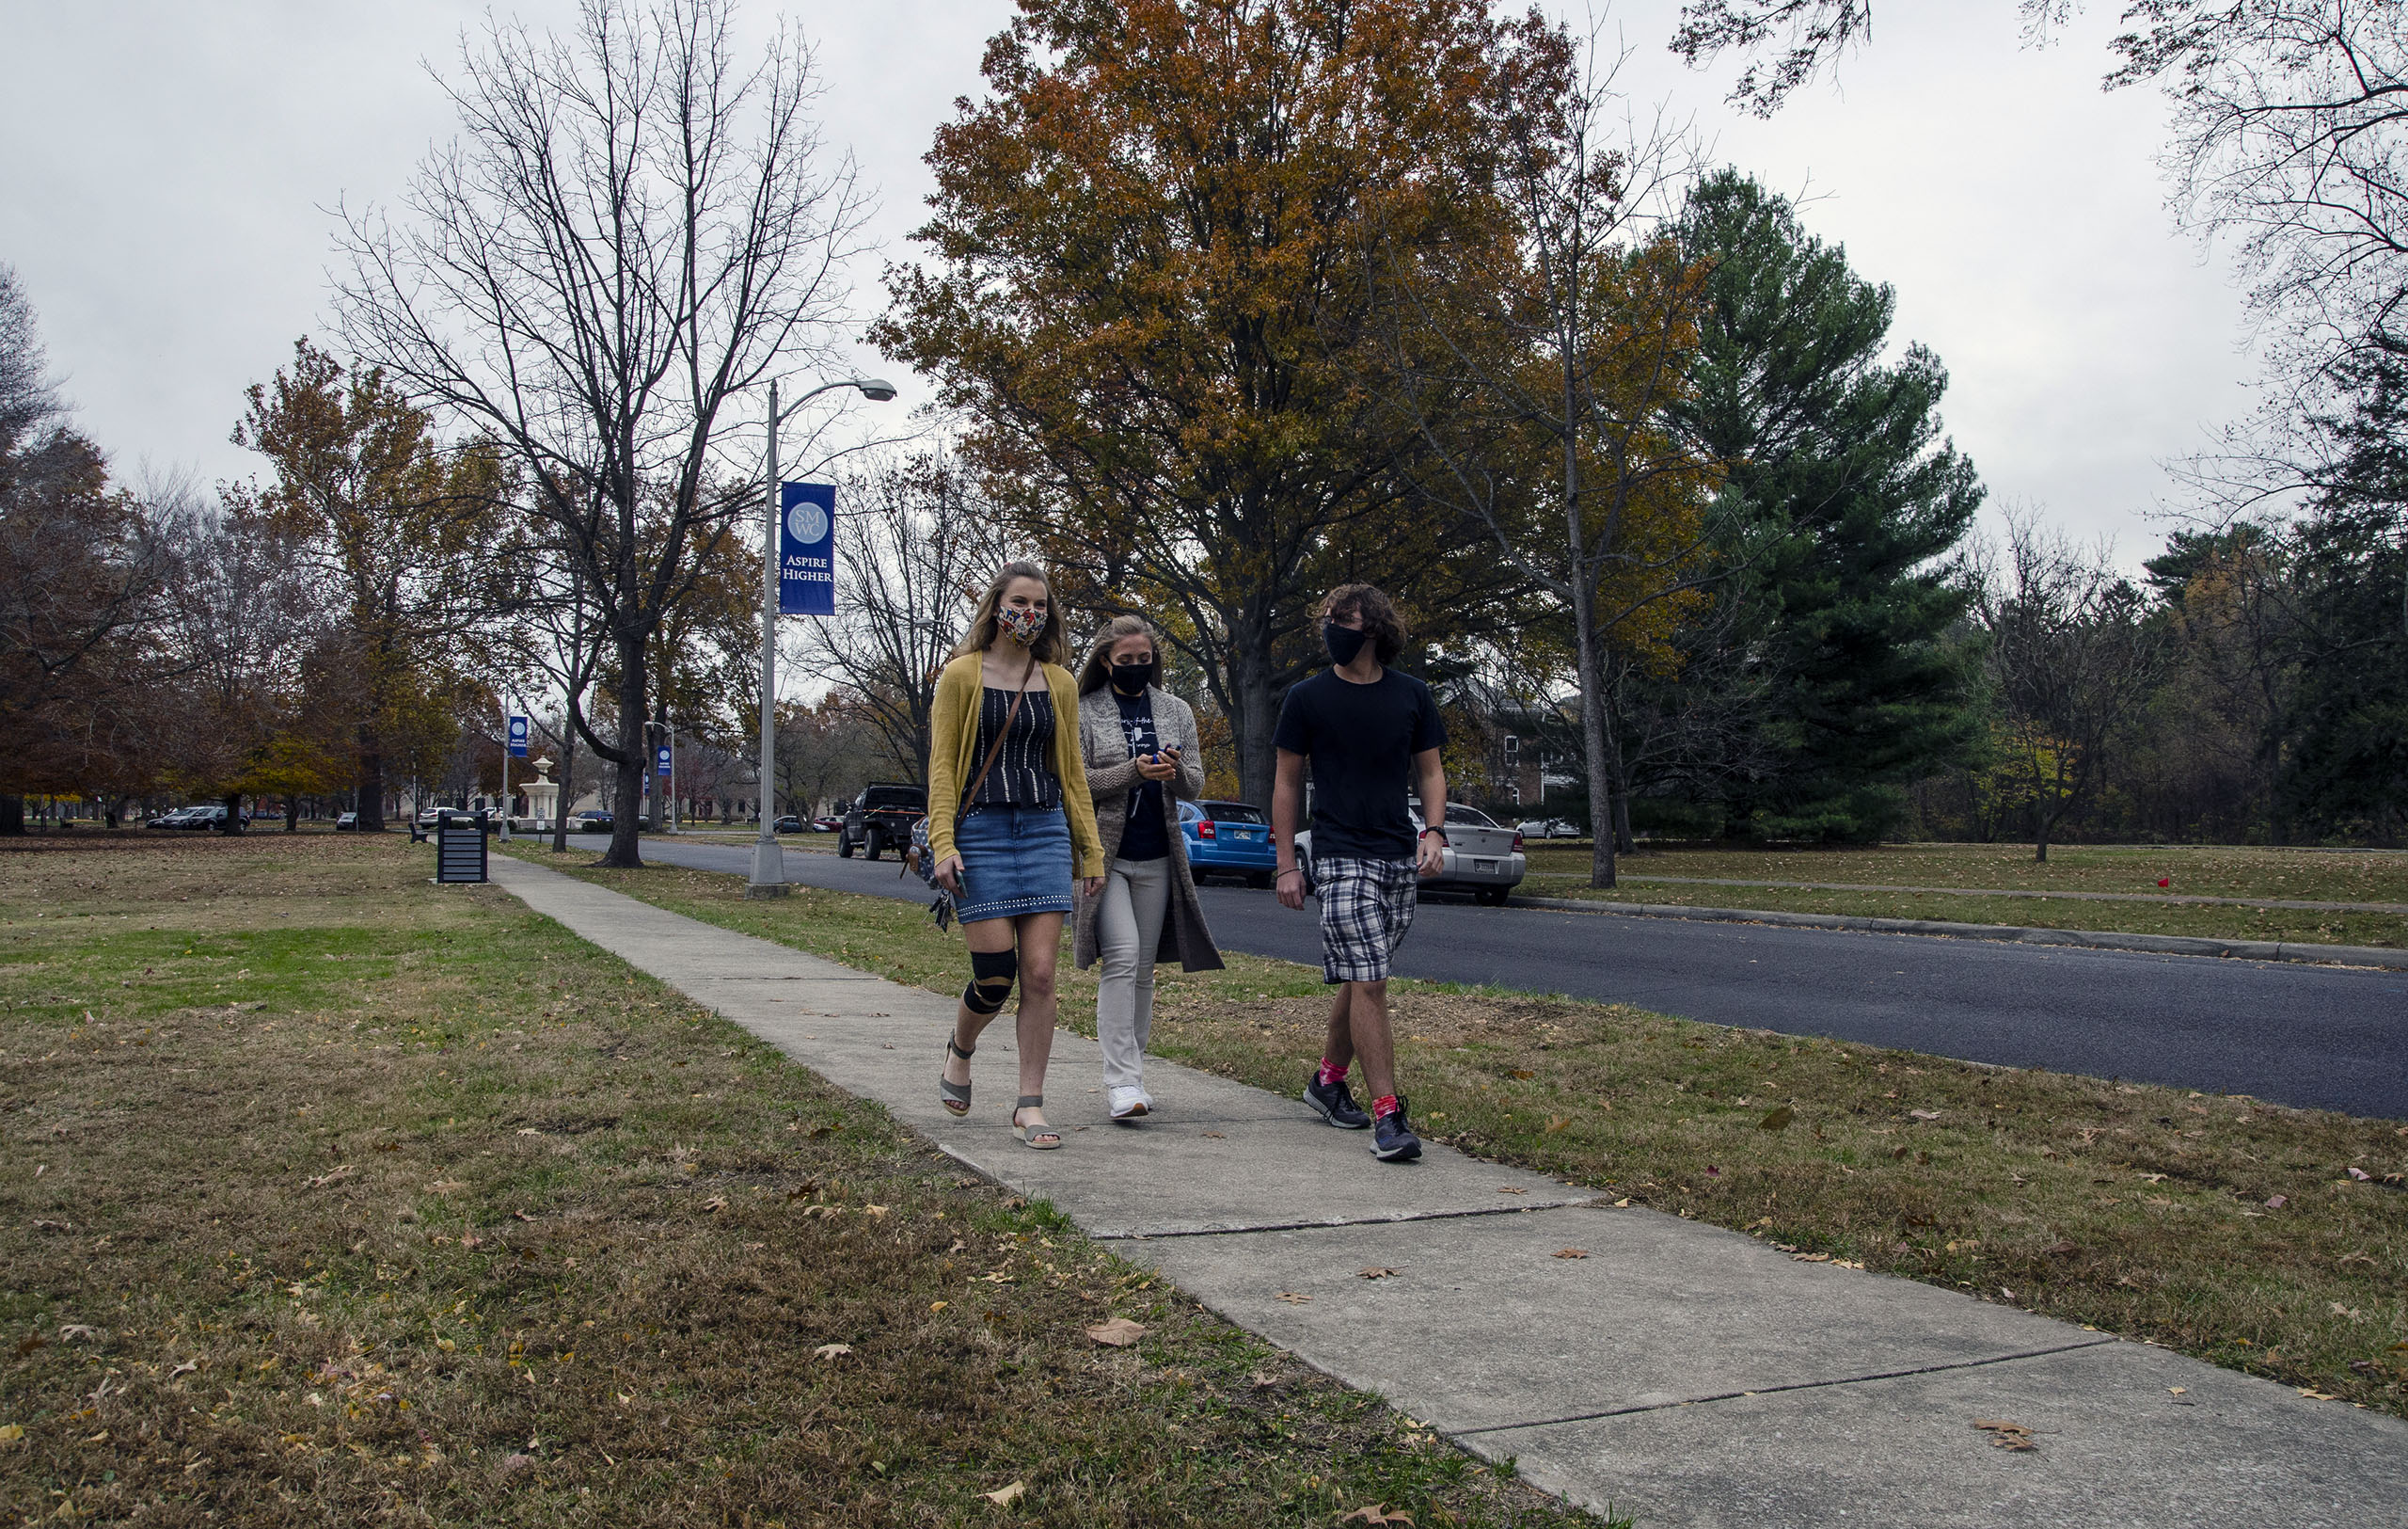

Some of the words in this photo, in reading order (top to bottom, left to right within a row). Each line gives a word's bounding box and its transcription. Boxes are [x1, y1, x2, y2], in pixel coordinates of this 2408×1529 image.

[796, 509, 821, 523] SM
[795, 522, 820, 536] WC
[786, 554, 828, 568] ASPIRE
[784, 568, 832, 581] HIGHER
